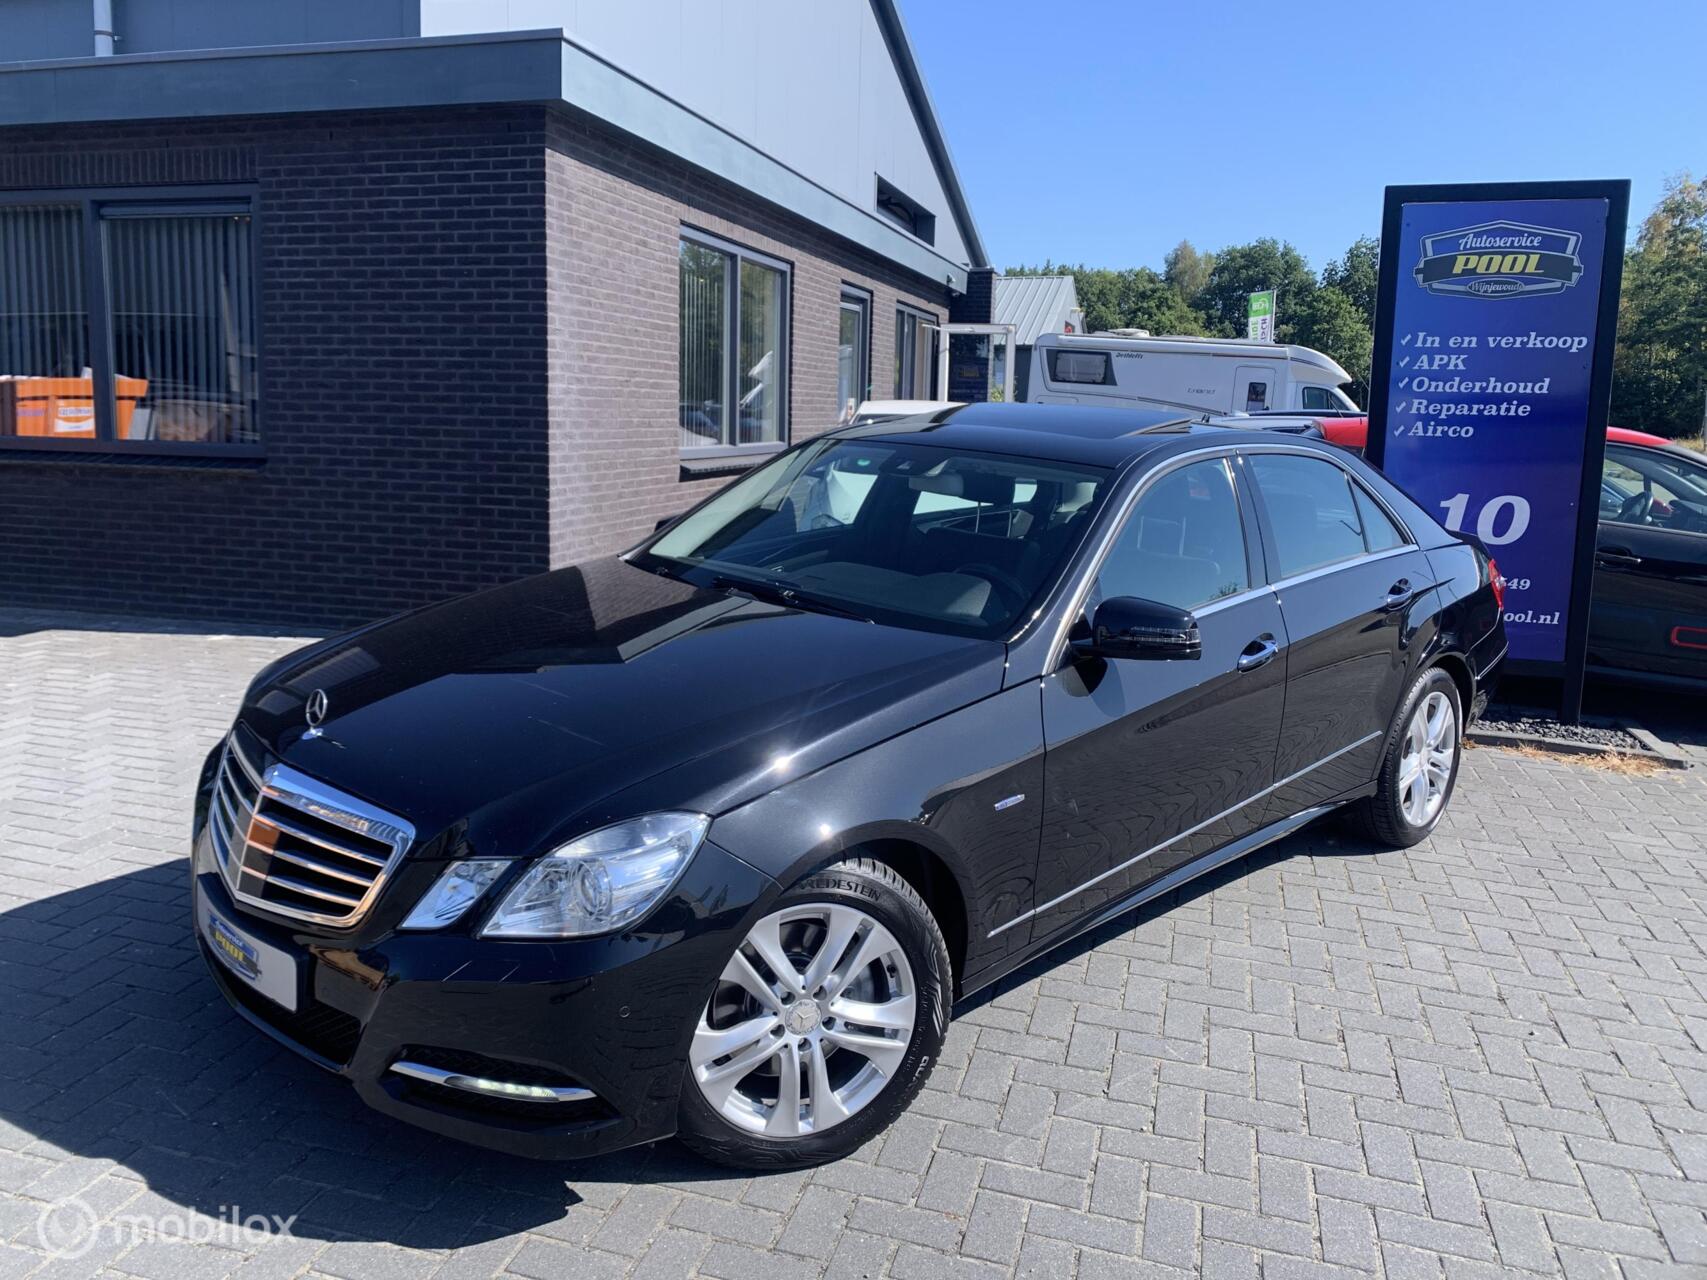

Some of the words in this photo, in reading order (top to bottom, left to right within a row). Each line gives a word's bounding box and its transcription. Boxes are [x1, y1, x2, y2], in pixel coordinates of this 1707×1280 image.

[1459, 233, 1542, 250] Autoservice
[1452, 254, 1545, 274] POOL
[1414, 332, 1440, 348] In
[1448, 336, 1478, 348] en
[1487, 331, 1588, 353] verkoop
[1412, 354, 1469, 370] APK
[1411, 376, 1551, 394] Onderhoud
[1408, 398, 1531, 419] Reparatie
[1407, 420, 1475, 438] Airco
[1439, 493, 1531, 545] 10
[1503, 610, 1560, 625] ool.nl
